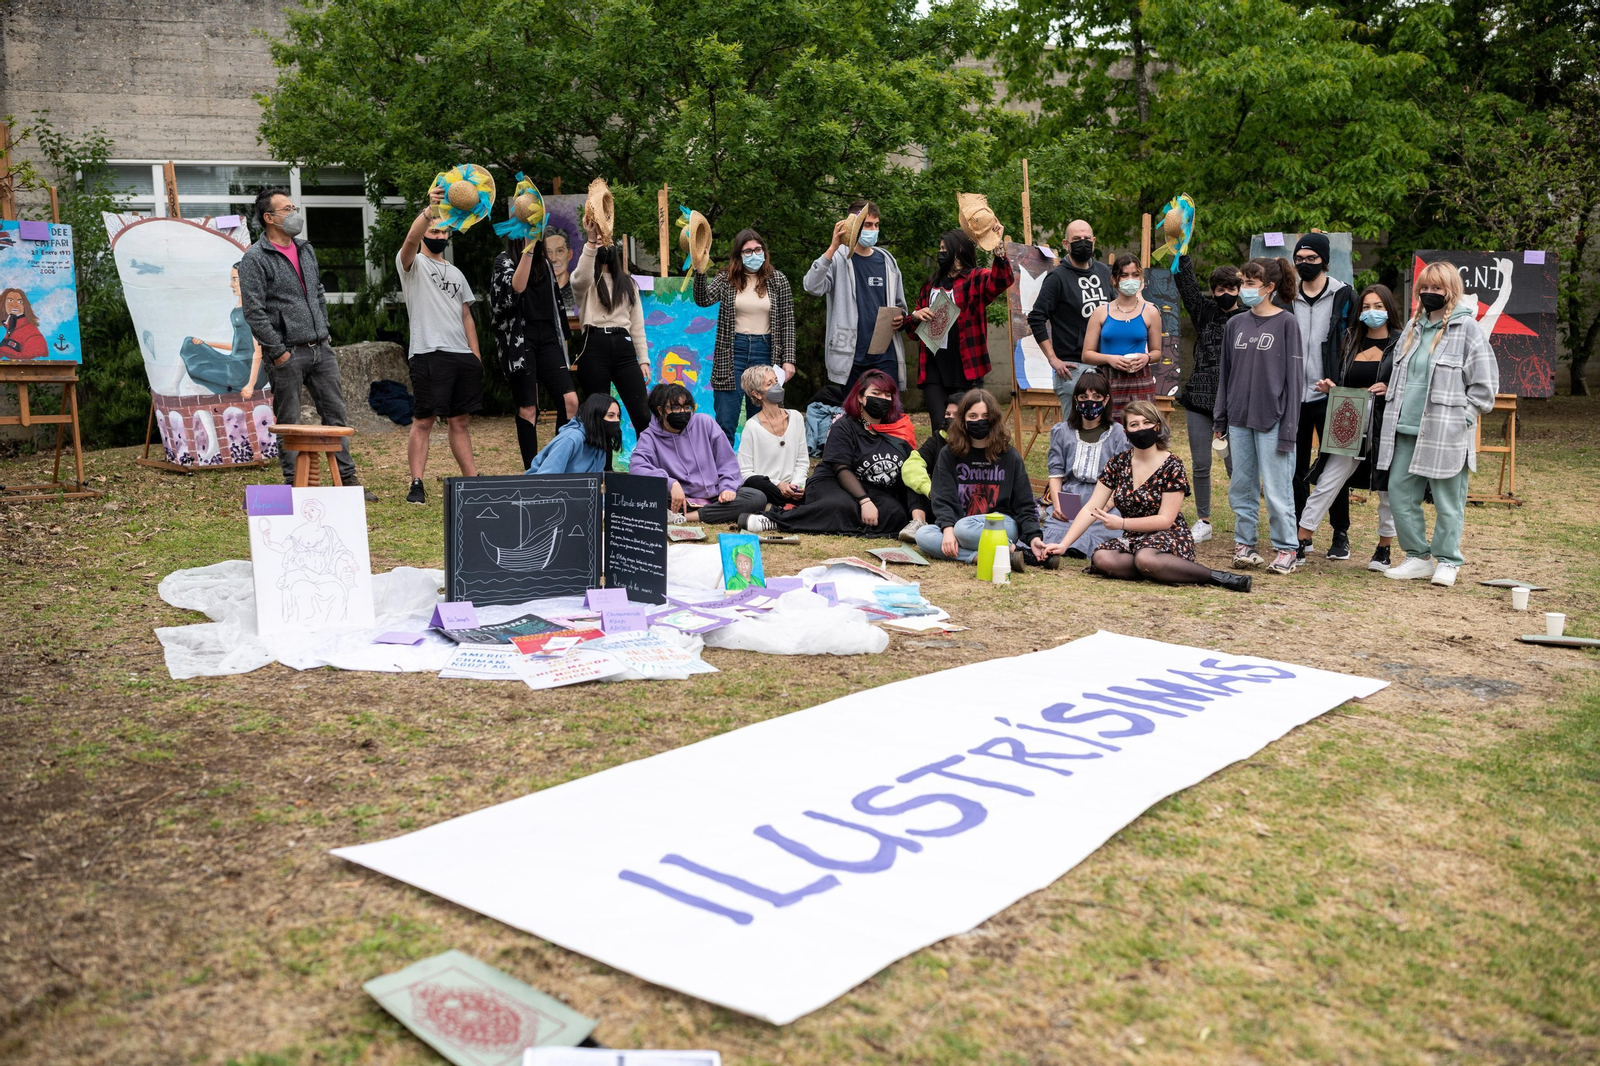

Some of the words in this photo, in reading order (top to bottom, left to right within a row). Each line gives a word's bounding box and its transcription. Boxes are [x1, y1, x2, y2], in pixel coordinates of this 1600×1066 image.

[51, 228, 68, 236] DEE
[1082, 287, 1108, 303] ALL
[1235, 332, 1247, 349] L
[1257, 333, 1274, 350] D
[872, 453, 904, 467] CLASS
[956, 463, 1005, 481] Dracula
[636, 500, 649, 509] siglo
[618, 655, 1296, 926] ILUSTRÍSIMAS
